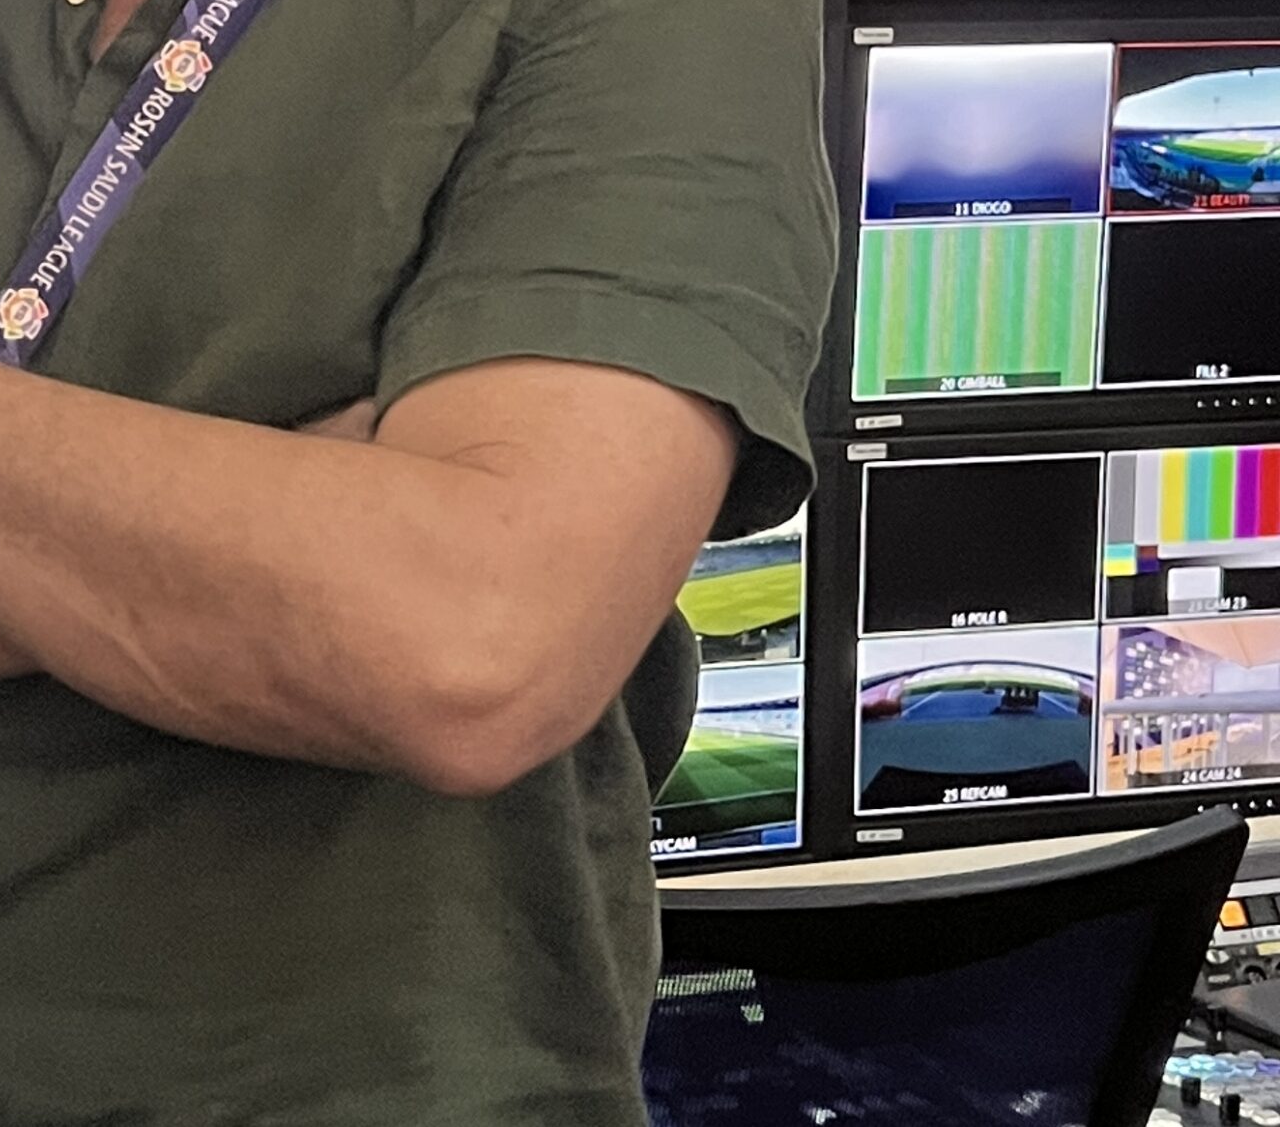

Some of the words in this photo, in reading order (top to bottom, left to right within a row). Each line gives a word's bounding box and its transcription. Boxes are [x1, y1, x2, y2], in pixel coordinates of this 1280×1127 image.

[115, 87, 174, 160] ROSHN
[76, 154, 128, 218] SAUDI
[30, 215, 91, 292] LEAGUE
[1204, 597, 1232, 611] CAM
[1199, 768, 1226, 783] CAM
[1226, 766, 1242, 780] 24
